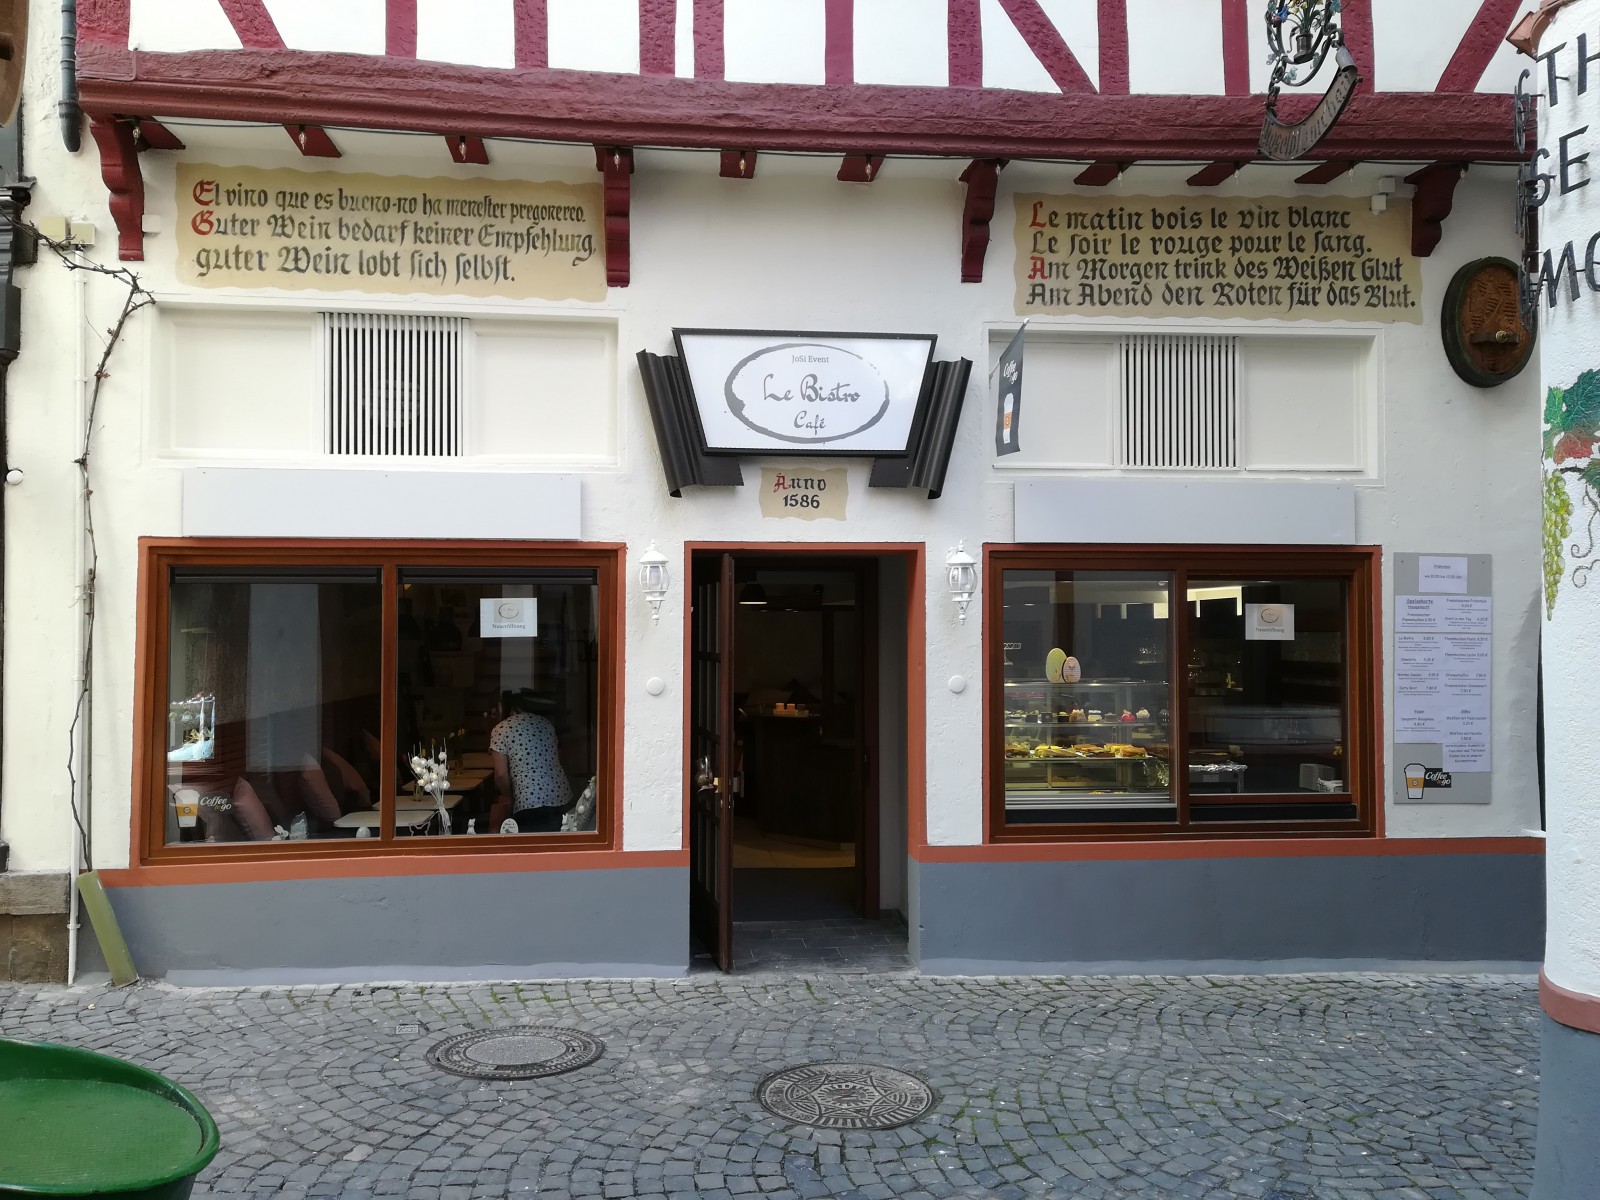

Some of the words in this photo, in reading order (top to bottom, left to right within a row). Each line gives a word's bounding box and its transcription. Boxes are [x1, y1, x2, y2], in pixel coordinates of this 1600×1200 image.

[192, 179, 221, 207] El
[224, 182, 268, 207] vino
[275, 189, 309, 212] que
[314, 192, 334, 211] es
[422, 192, 442, 218] ha
[191, 209, 260, 236] Guter
[266, 214, 333, 240] Wein
[338, 216, 411, 246] bedarf
[413, 220, 474, 246] keiner
[1029, 200, 1060, 228] Le
[1066, 206, 1145, 231] matin
[1150, 205, 1203, 230] bois
[1210, 207, 1228, 229] le
[1237, 205, 1281, 229] vin
[1287, 205, 1351, 228] blanc
[1030, 230, 1059, 255] Le
[1120, 232, 1141, 255] le
[1149, 234, 1223, 259] rouge
[1228, 234, 1282, 257] pour
[1287, 231, 1306, 253] le
[195, 244, 269, 278] guter
[277, 246, 352, 275] Wein
[358, 249, 401, 278] lobt
[1028, 255, 1070, 280] Am
[1077, 257, 1170, 286] Morgen
[1174, 257, 1228, 281] trink
[1233, 256, 1269, 279] des
[1273, 254, 1357, 285] Weißen
[1361, 257, 1404, 282] Glut
[1025, 282, 1073, 307] Am
[1076, 281, 1153, 307] Abend
[1161, 281, 1205, 306] den
[1212, 281, 1284, 306] Roten
[1286, 281, 1322, 313] für
[1326, 281, 1361, 306] das
[1363, 283, 1416, 309] Blut.
[791, 354, 807, 364] JoSi
[808, 355, 830, 363] Event
[763, 373, 794, 402] Le
[799, 373, 861, 402] Bistro
[793, 410, 826, 436] Café
[773, 472, 826, 493] Anno
[782, 493, 820, 509] 1586
[1425, 771, 1448, 781] Coffee
[1440, 778, 1451, 787] go
[199, 795, 228, 807] Coffee
[219, 803, 232, 812] go
